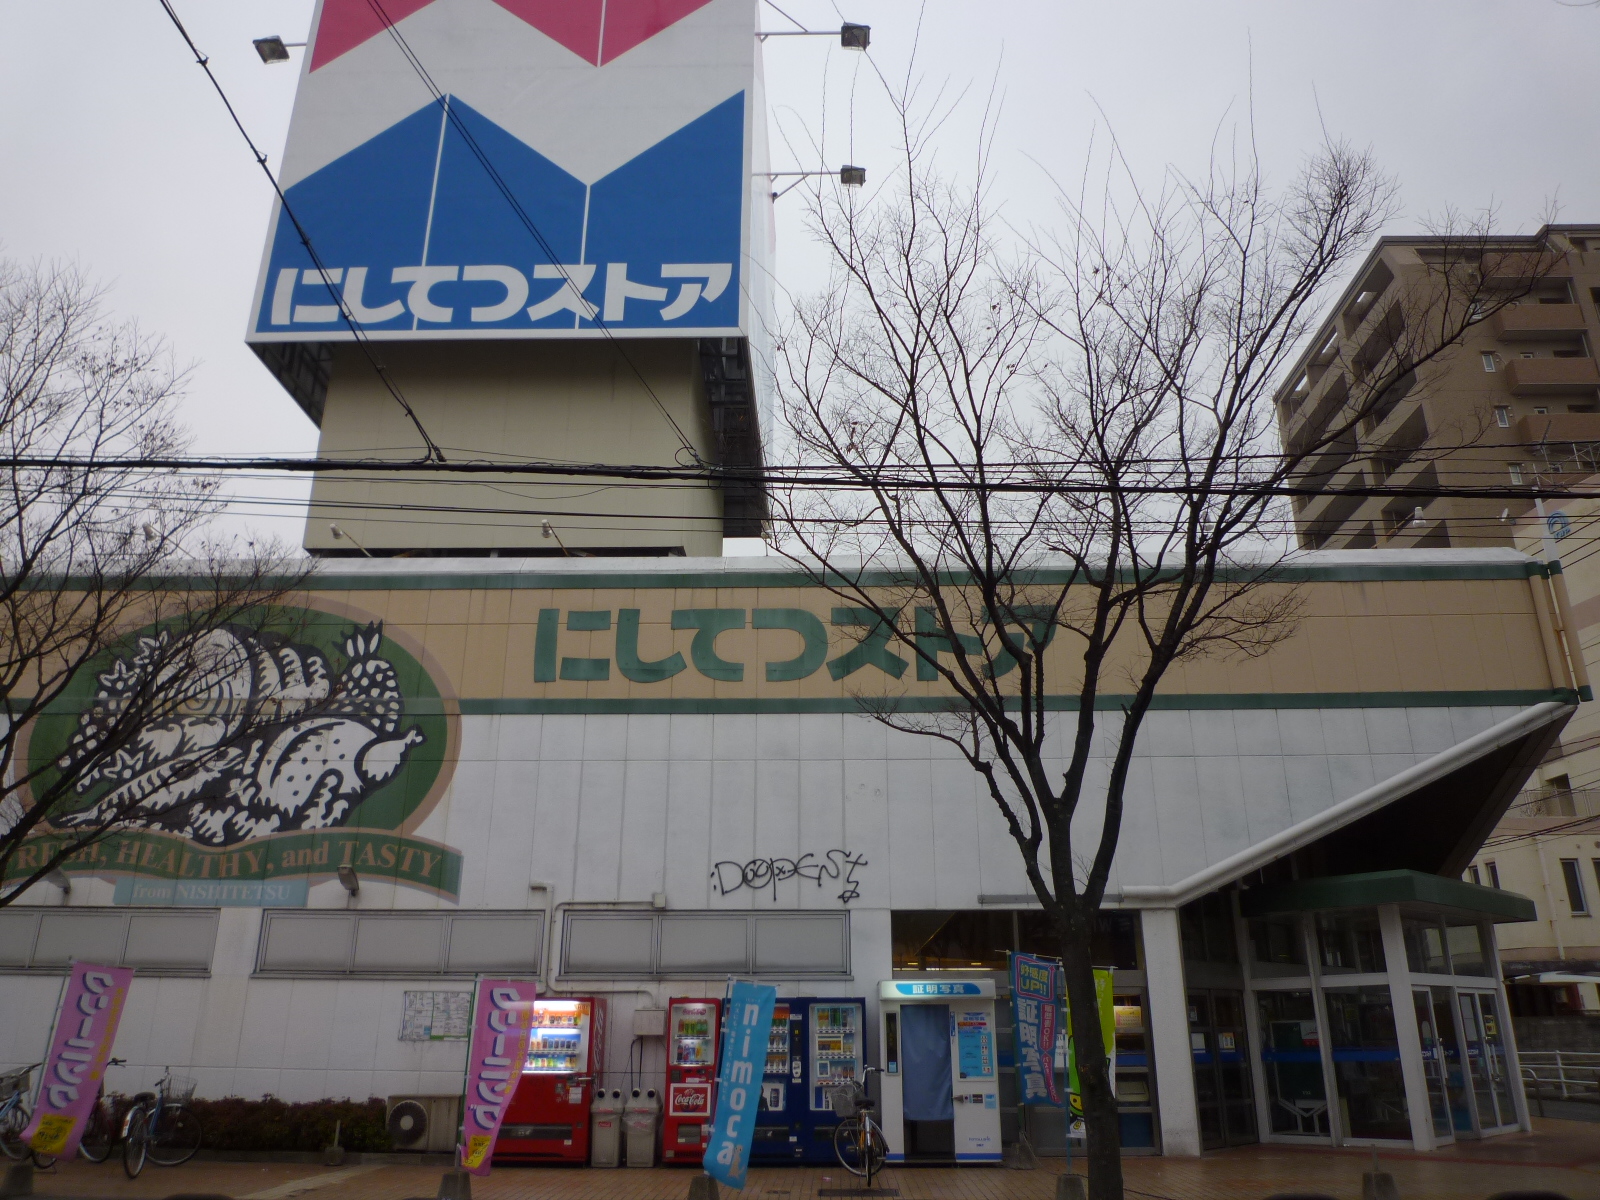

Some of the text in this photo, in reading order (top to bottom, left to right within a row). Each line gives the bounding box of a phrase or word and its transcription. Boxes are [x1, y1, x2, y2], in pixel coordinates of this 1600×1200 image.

[271, 262, 732, 325] にしてつストア
[534, 606, 1057, 683] にしてつストア
[115, 839, 274, 878] HEALTHY,
[282, 841, 329, 867] and
[338, 841, 443, 878] TASTY
[132, 884, 291, 900] from NISHITETSU
[912, 983, 965, 994] 証明写真
[1020, 978, 1047, 995] UP!!
[45, 971, 114, 1109] クリーニング
[468, 986, 520, 1130] クリーニング
[1016, 997, 1048, 1098] 証明写真
[716, 1003, 759, 1165] nimoca
